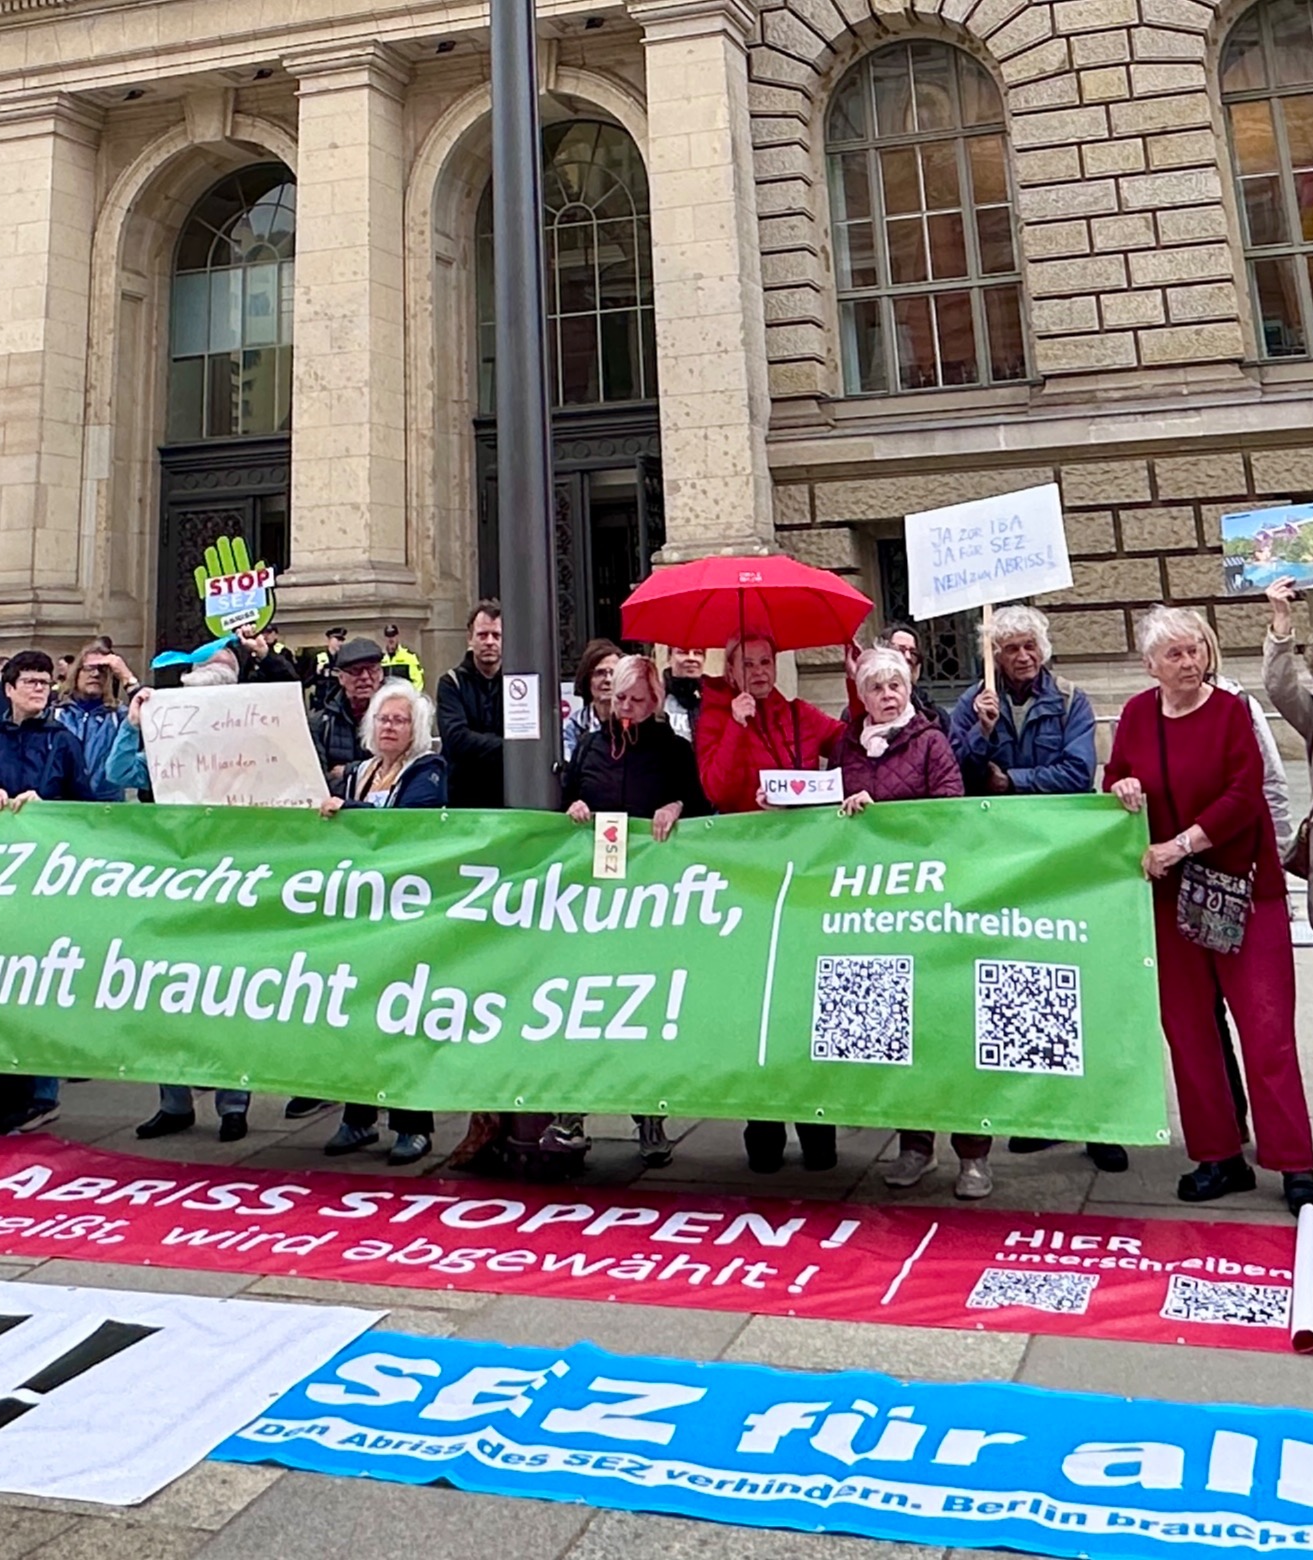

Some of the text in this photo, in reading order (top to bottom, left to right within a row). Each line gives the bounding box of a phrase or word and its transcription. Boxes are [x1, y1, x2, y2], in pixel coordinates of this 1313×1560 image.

[930, 527, 952, 548] JA
[933, 546, 955, 567] JA
[990, 534, 1027, 554] SEZ
[209, 569, 270, 597] STOP
[933, 569, 968, 595] NEIN
[217, 590, 257, 612] SEZ
[147, 704, 281, 743] SEZ erhalten
[265, 754, 278, 765] in
[764, 779, 836, 793] ICH SEZ
[605, 844, 619, 874] SEZ
[32, 842, 273, 907] braucht
[280, 859, 432, 922] eine
[445, 862, 743, 936] Zukunft,
[830, 860, 947, 898] HIER
[821, 902, 1089, 944] unterschreiben:
[94, 937, 358, 1027] braucht
[376, 963, 508, 1045] das
[520, 968, 689, 1042] SEZ!
[1003, 1228, 1143, 1256] HIER
[161, 1223, 339, 1257] wird
[341, 1236, 820, 1294] abgewählt!
[994, 1251, 1293, 1280] unterschreiben
[303, 1352, 708, 1446] SEZ
[737, 1399, 1028, 1466] für
[253, 1418, 331, 1441] Den
[344, 1429, 469, 1457] Abriss
[477, 1437, 550, 1468] des
[562, 1453, 658, 1480] SEZ
[665, 1465, 922, 1511] verhindern.
[941, 1494, 1088, 1526] Berlin
[1106, 1510, 1312, 1546] braucht
